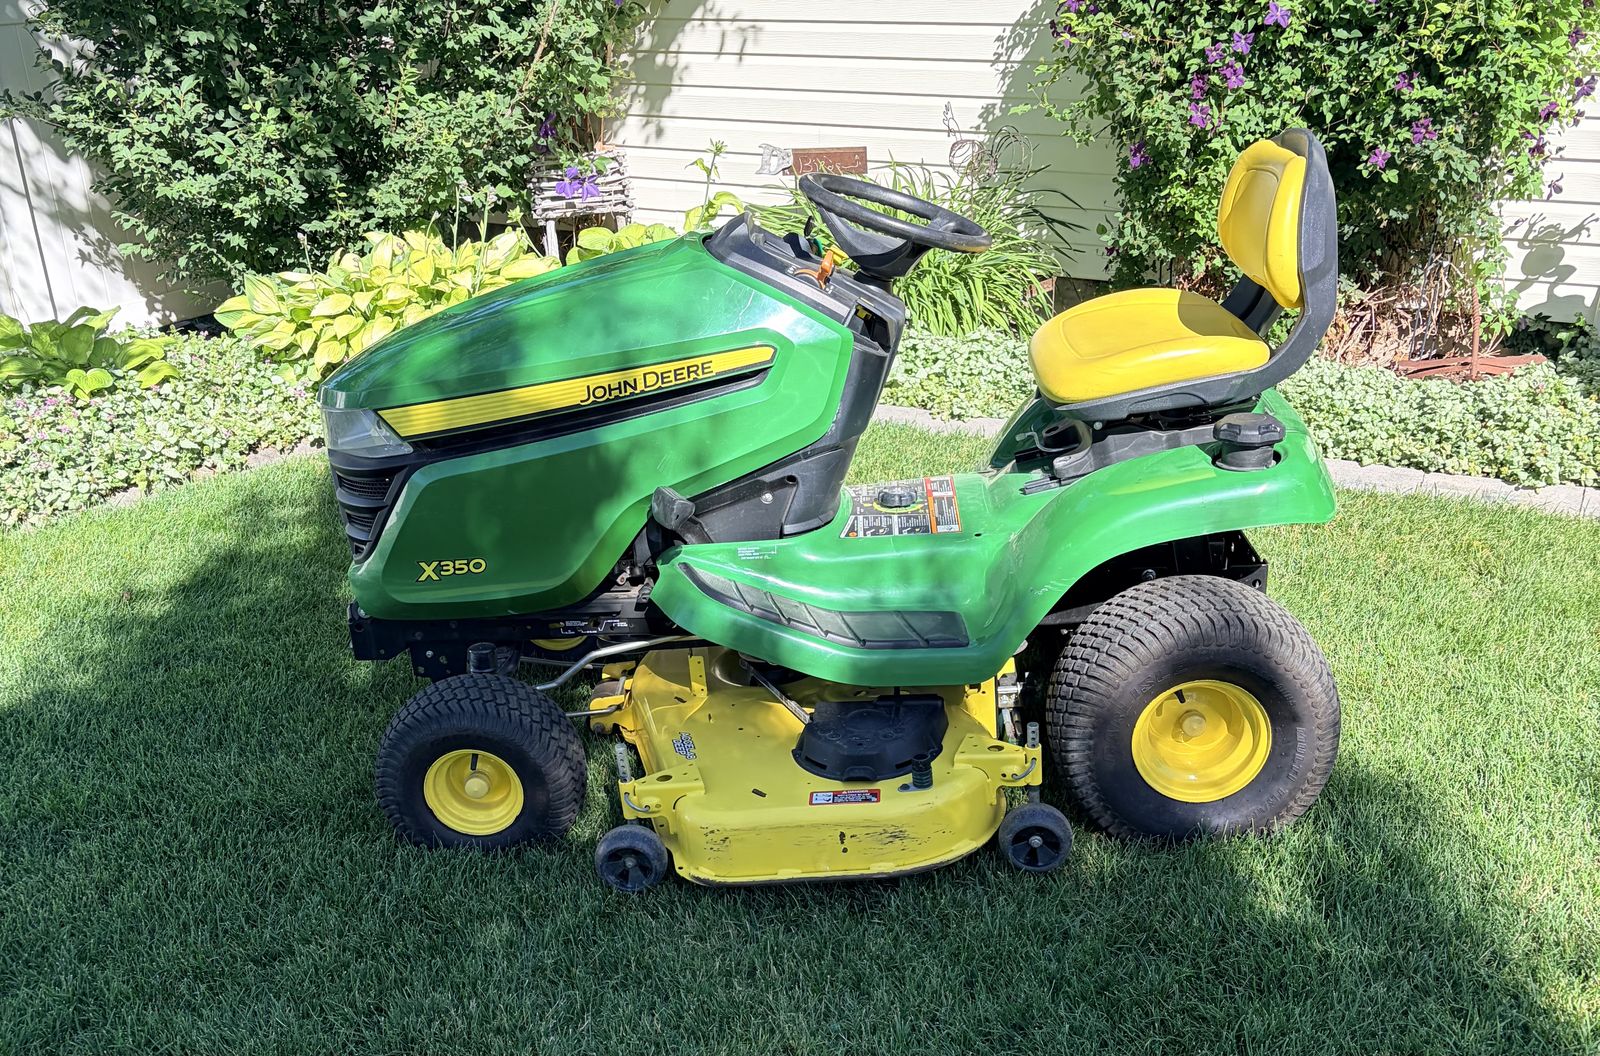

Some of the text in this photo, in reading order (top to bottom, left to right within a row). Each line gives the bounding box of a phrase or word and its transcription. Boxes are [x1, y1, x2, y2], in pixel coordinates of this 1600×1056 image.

[580, 360, 714, 403] JOHN DEERE
[416, 557, 487, 582] X350
